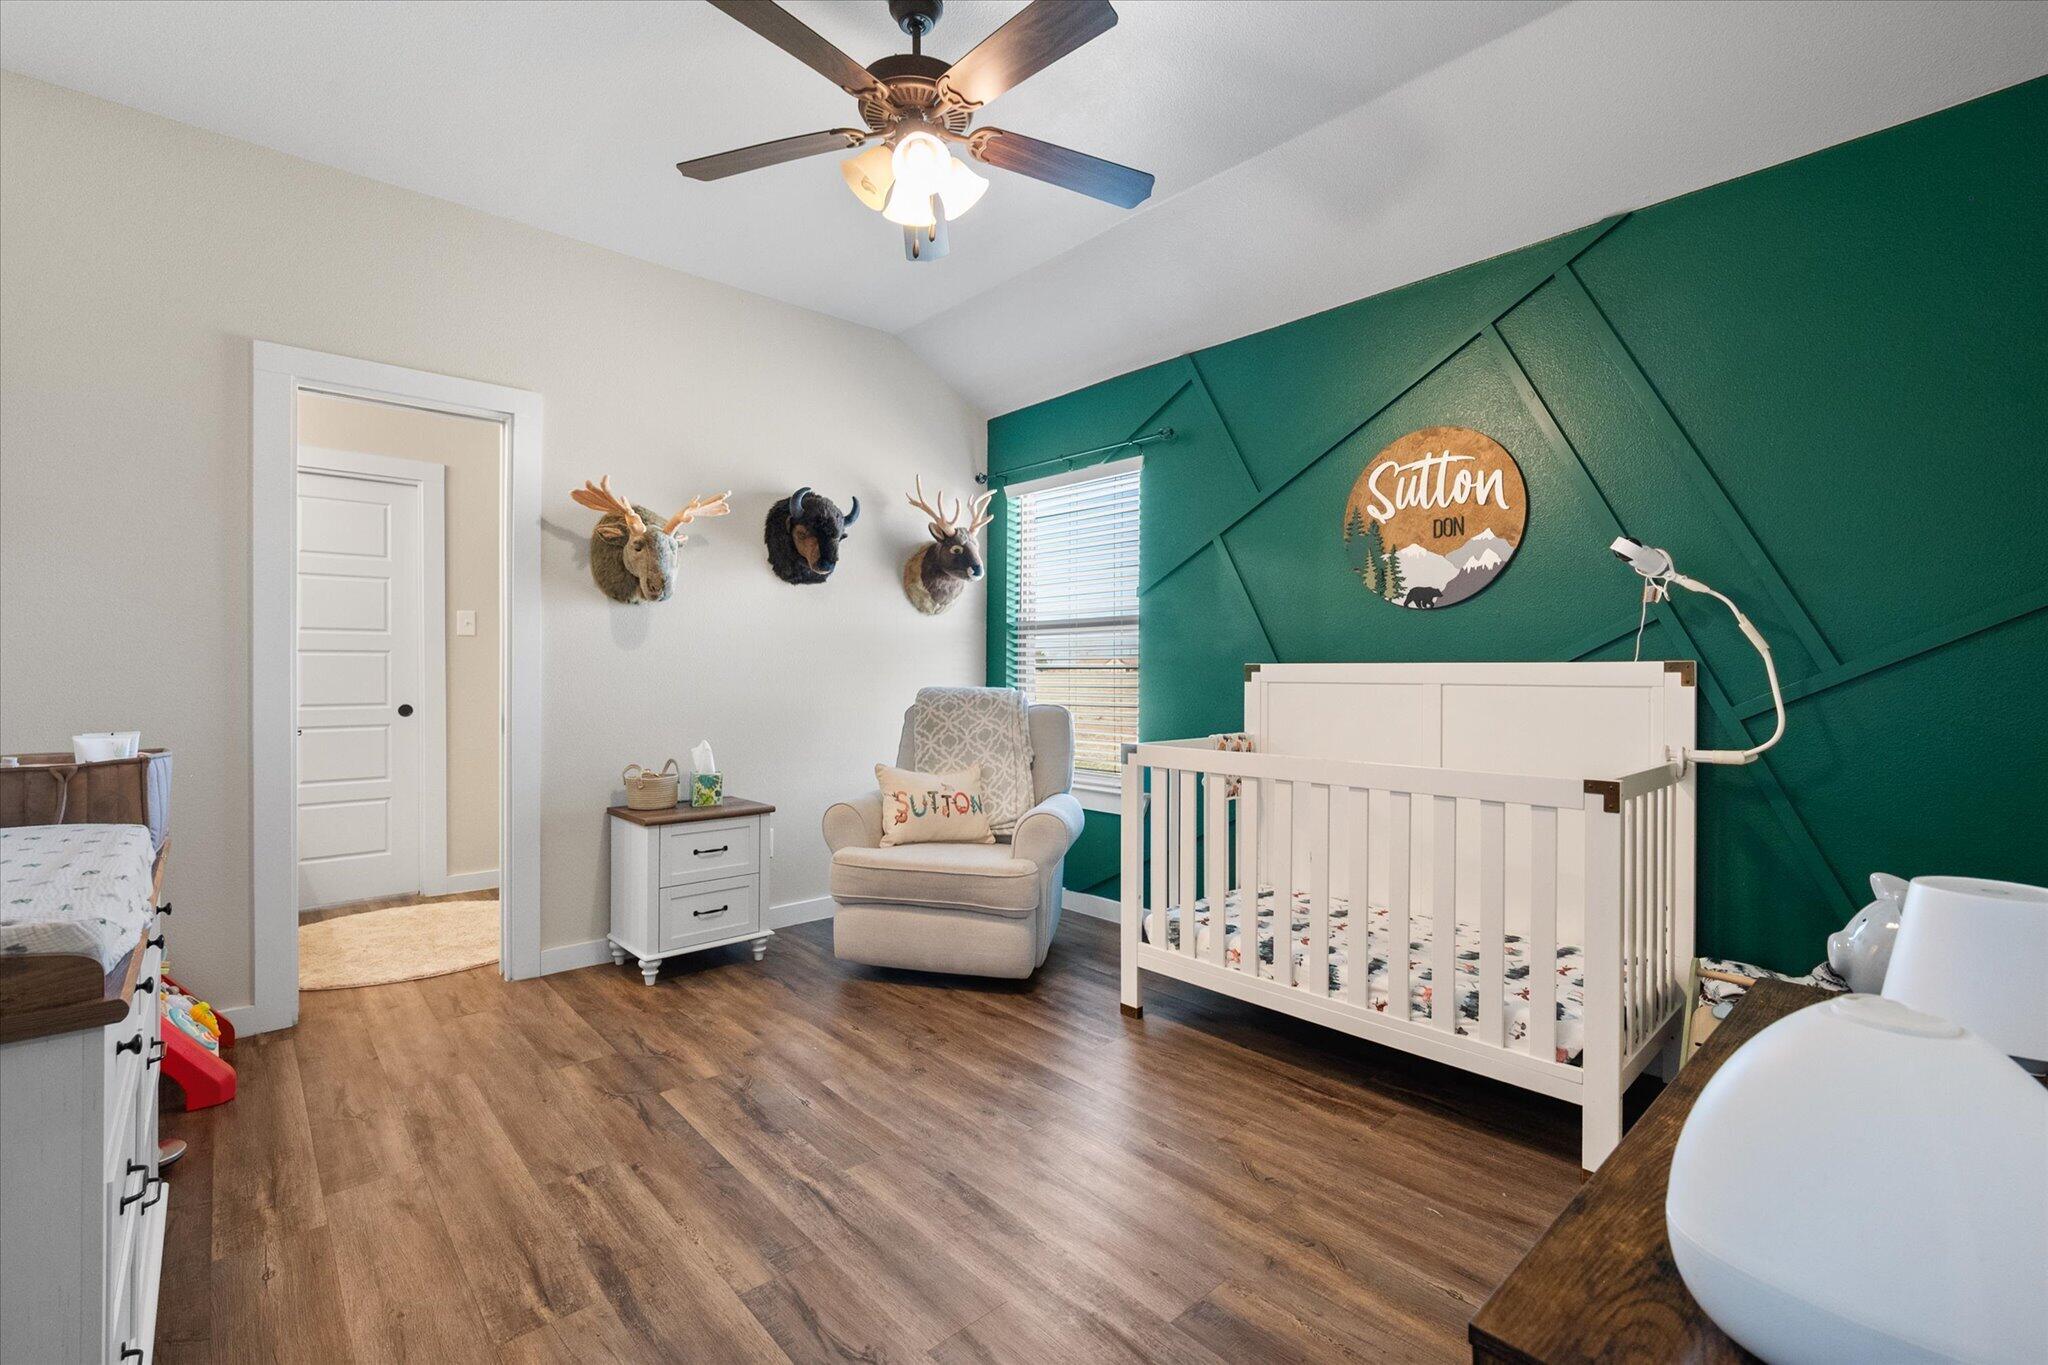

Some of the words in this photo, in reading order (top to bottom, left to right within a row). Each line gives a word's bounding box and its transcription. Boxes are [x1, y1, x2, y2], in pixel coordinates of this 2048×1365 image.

[1367, 449, 1510, 524] Sutton
[1433, 516, 1465, 538] DON
[894, 790, 983, 825] SUTTON
